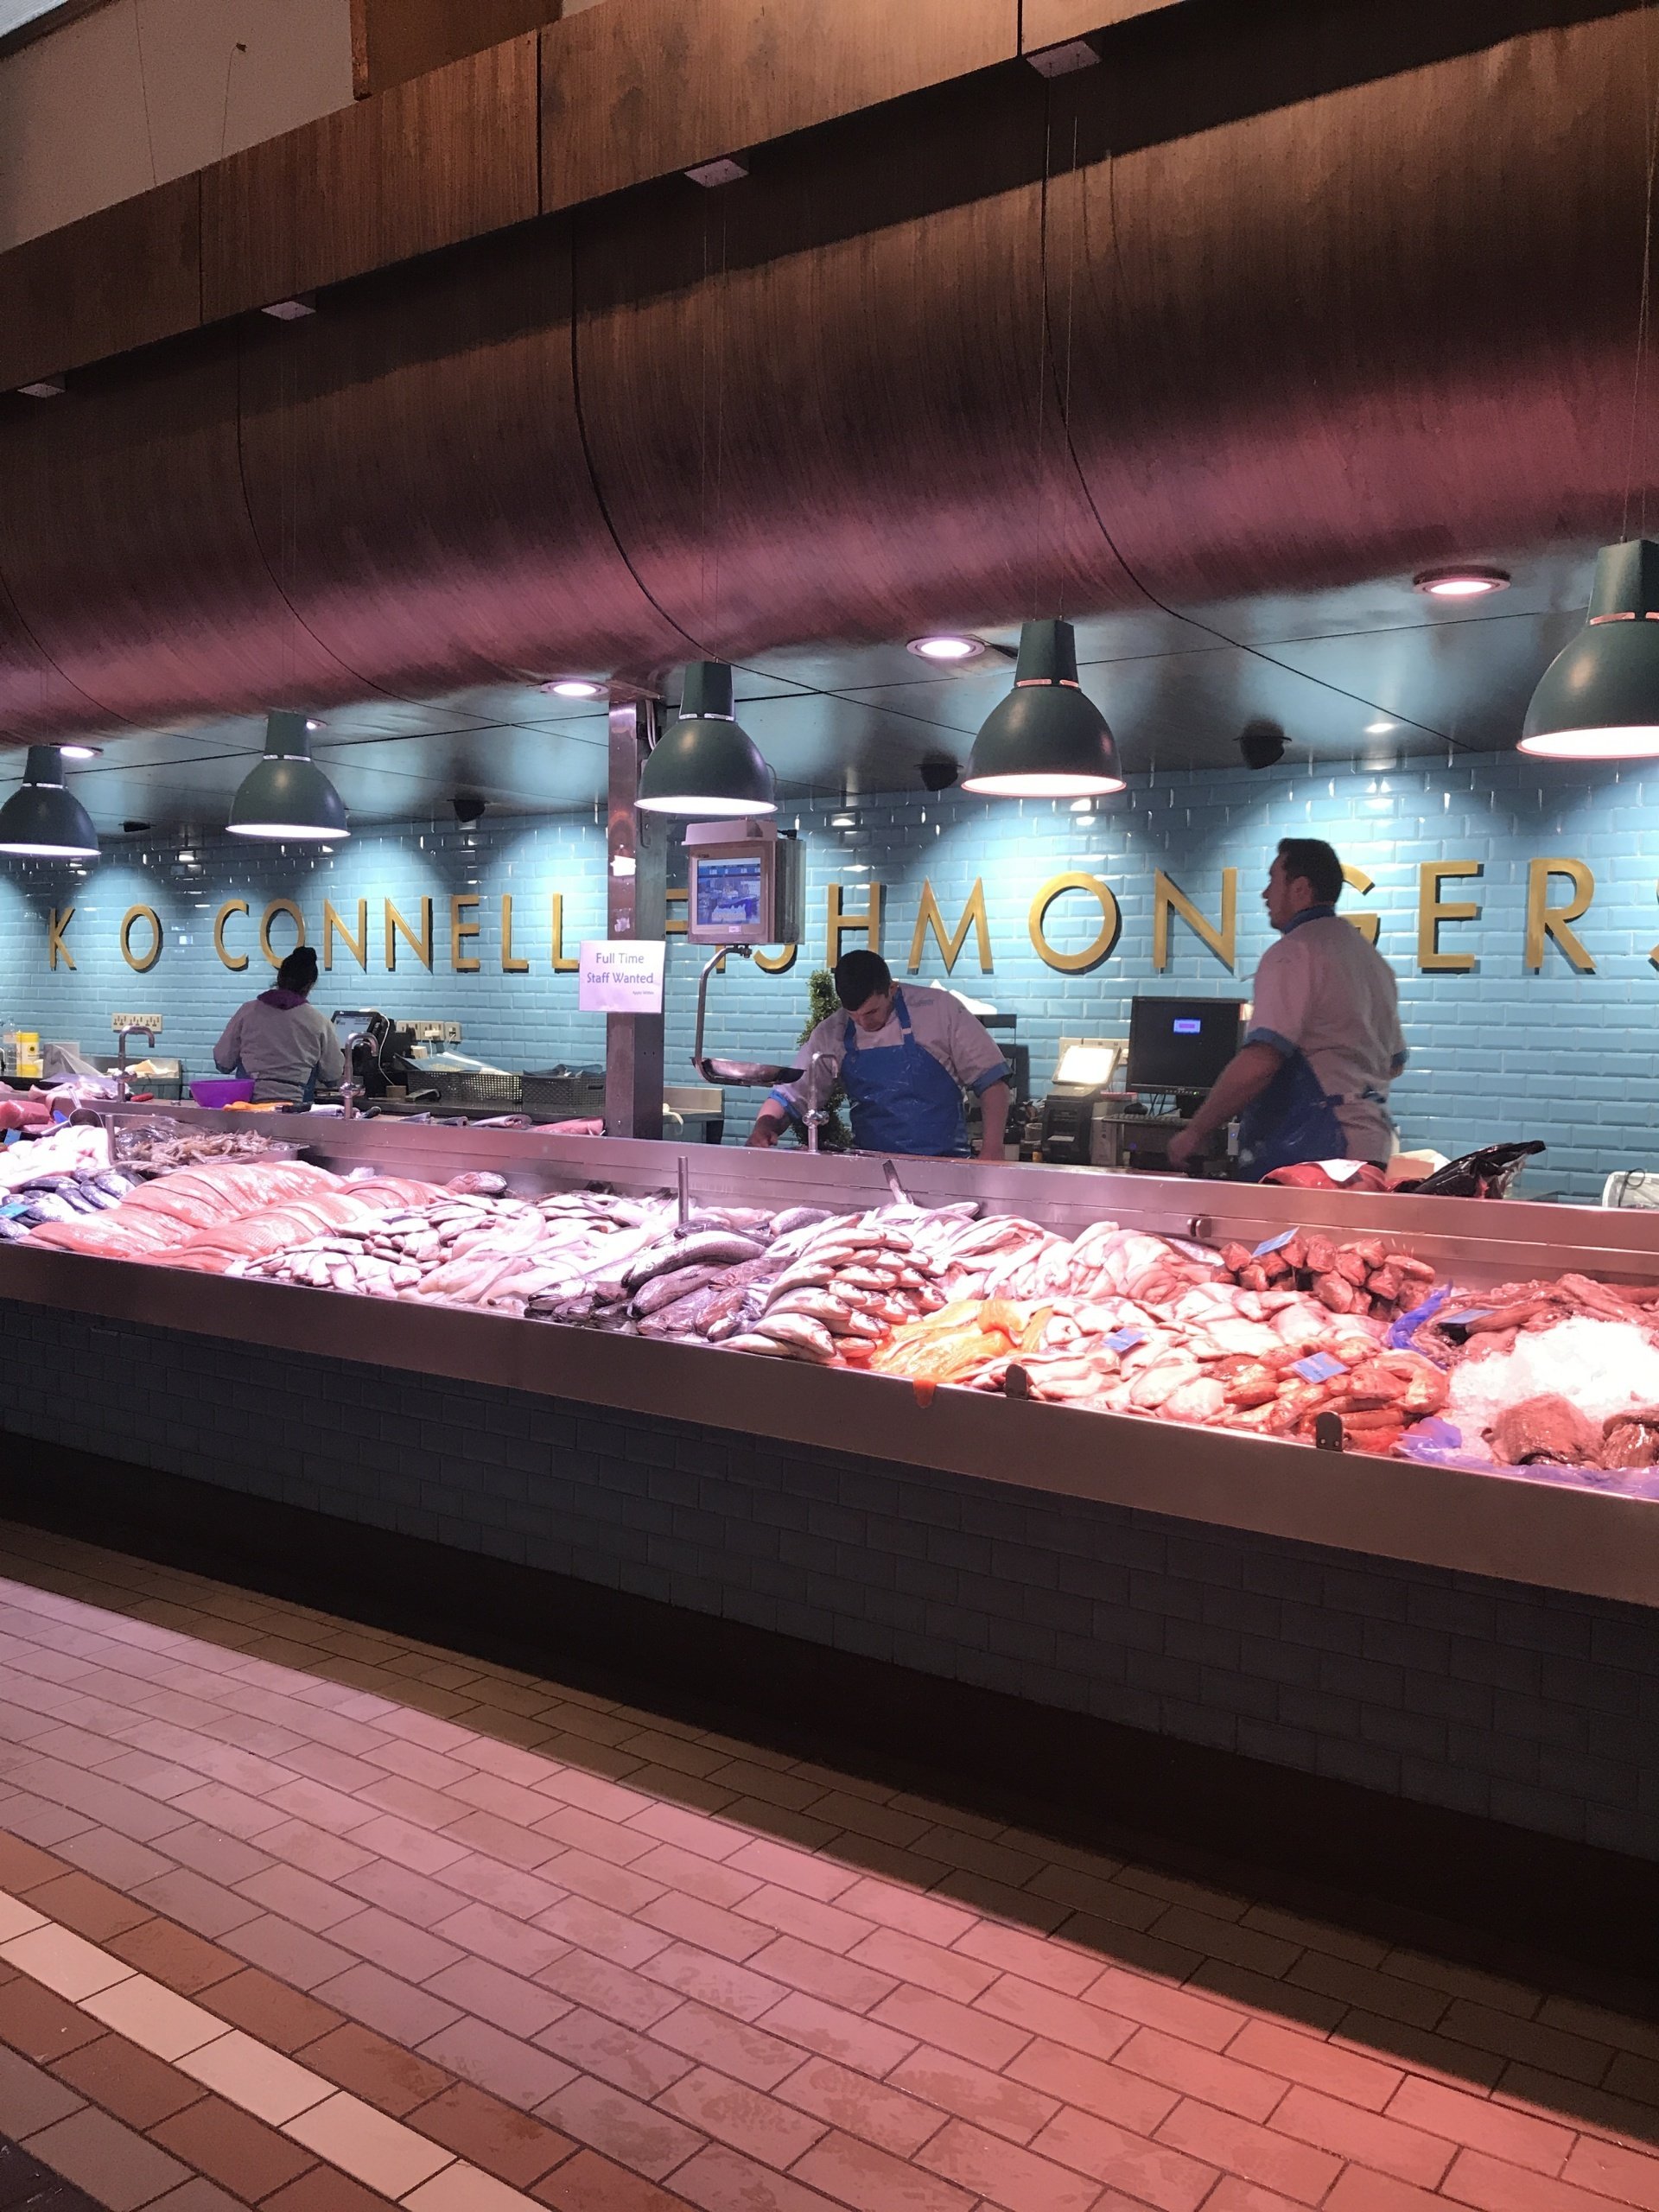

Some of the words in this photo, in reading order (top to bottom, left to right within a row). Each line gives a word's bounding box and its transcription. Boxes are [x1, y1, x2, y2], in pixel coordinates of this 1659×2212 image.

[49, 907, 76, 970] K
[120, 904, 162, 973] O
[213, 893, 580, 974] CONNELL
[595, 952, 615, 964] Full
[618, 952, 645, 964] Time
[587, 971, 610, 984] Staff
[612, 972, 654, 984] Wanted
